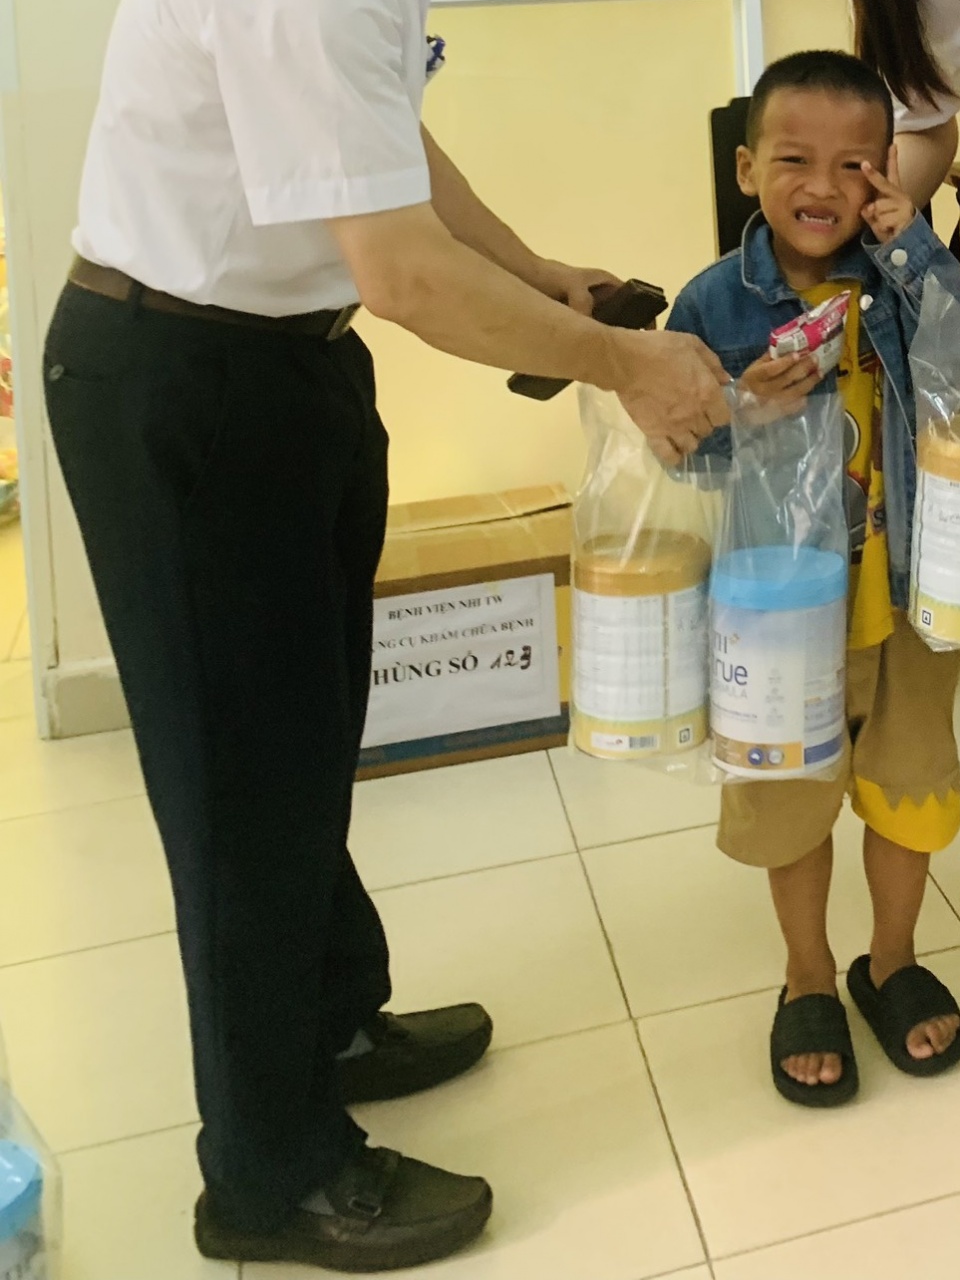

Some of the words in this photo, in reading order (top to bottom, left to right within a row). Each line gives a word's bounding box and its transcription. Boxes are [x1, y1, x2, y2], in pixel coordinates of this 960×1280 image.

[388, 606, 423, 621] BỆNH
[427, 602, 456, 616] VIỆN
[459, 598, 481, 609] NHI
[486, 594, 504, 606] TW
[399, 636, 416, 649] CỤ
[420, 628, 459, 644] KHÁM
[461, 623, 497, 638] CHỮA
[500, 618, 534, 632] BỆNH
[373, 660, 442, 686] HÙNG
[448, 650, 479, 674] SỐ
